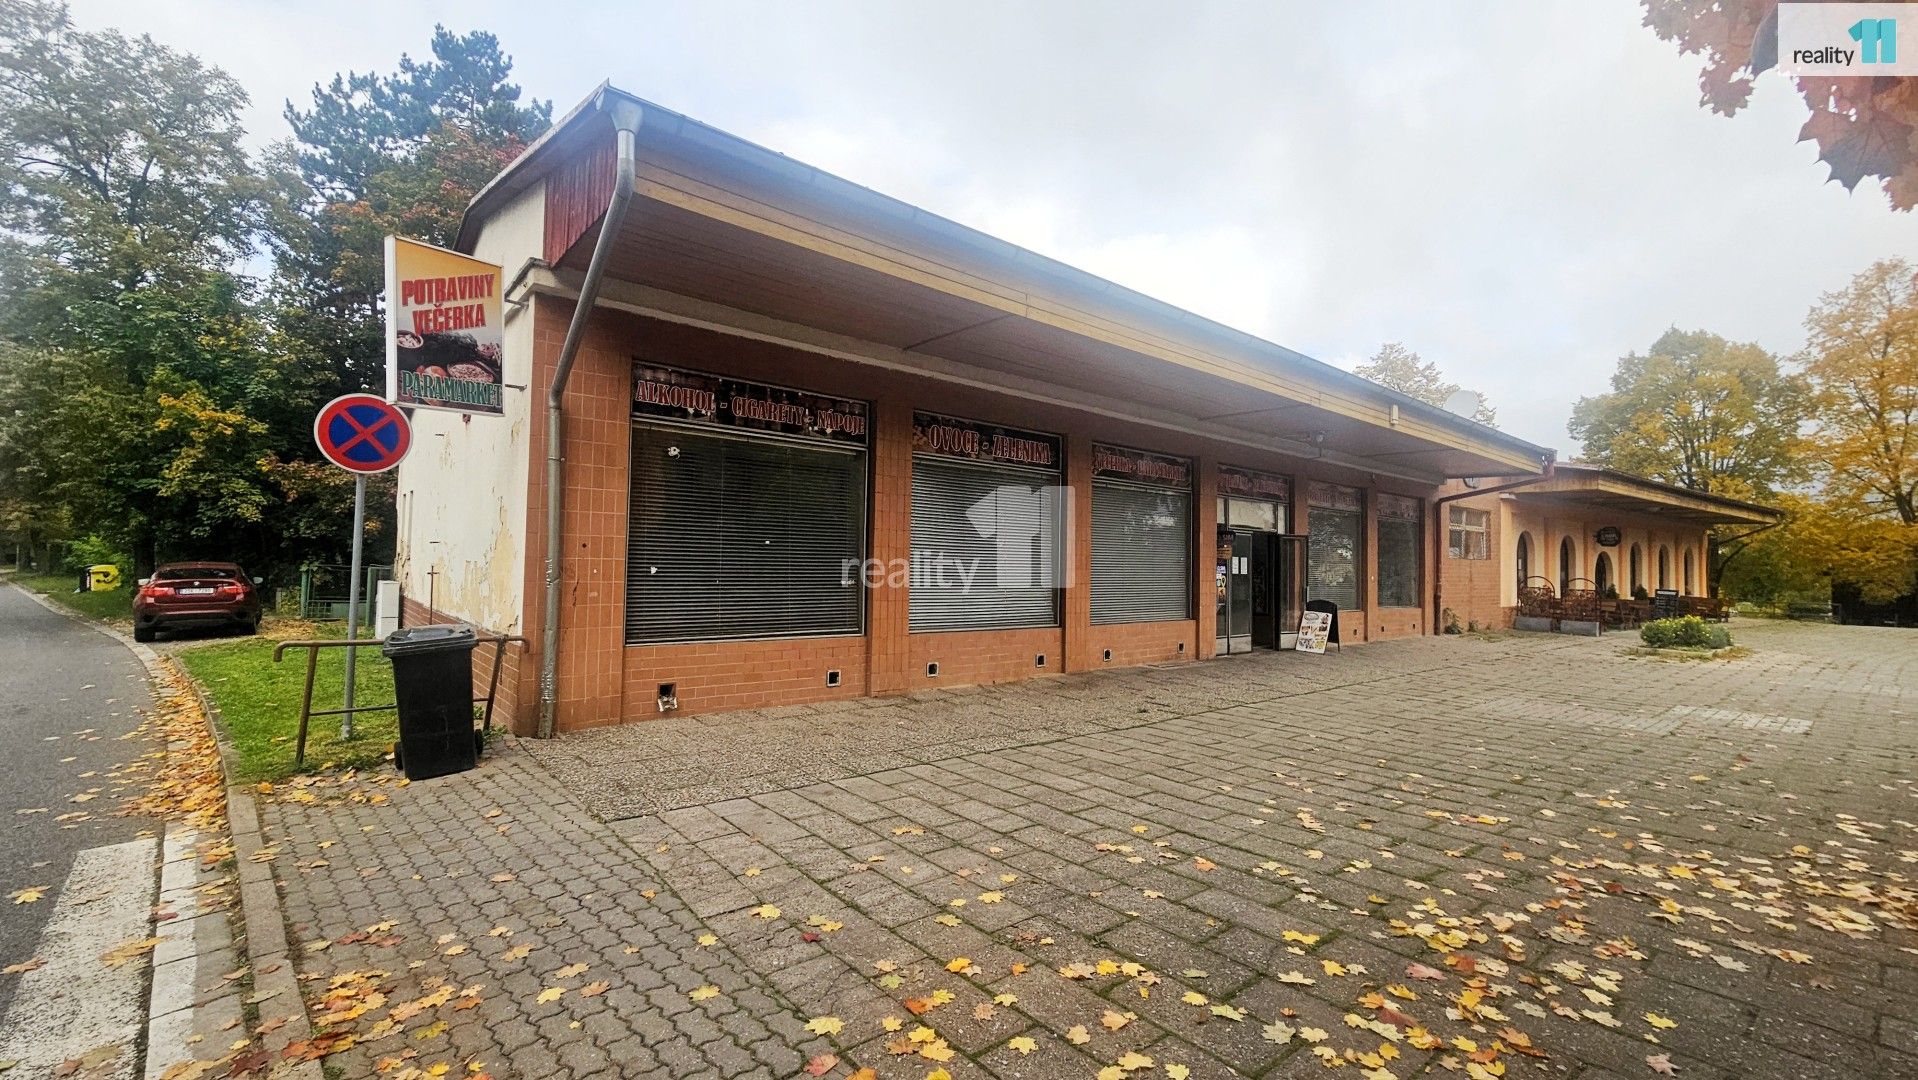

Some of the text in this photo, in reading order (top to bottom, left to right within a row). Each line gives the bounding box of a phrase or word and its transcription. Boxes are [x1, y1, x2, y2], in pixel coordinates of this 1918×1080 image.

[401, 274, 495, 307] POTRAVINY
[412, 303, 487, 336] VEČERKA
[401, 370, 502, 408] PARAMARKET
[635, 380, 717, 412] ALKOHOL
[731, 396, 805, 426] CIGARETY
[817, 408, 865, 436] NÁPOJE
[929, 424, 980, 455] OVOCE
[992, 434, 1052, 465] ZELENINA
